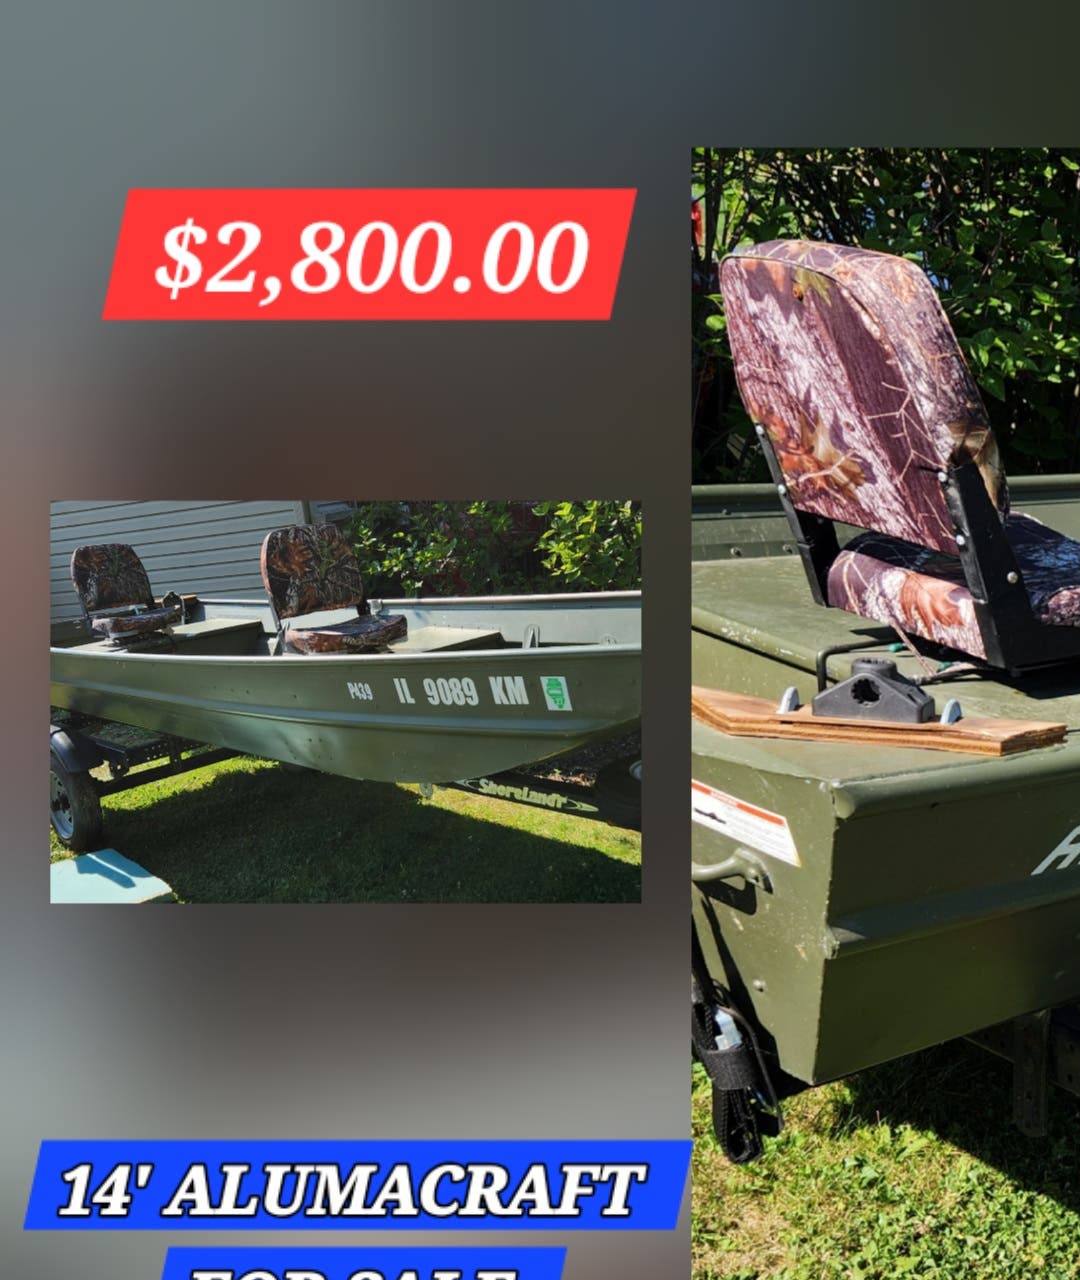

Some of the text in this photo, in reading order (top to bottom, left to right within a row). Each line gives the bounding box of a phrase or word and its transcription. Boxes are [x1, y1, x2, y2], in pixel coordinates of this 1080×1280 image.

[393, 678, 415, 704] IL
[423, 677, 479, 706] 9089
[488, 676, 529, 705] KM
